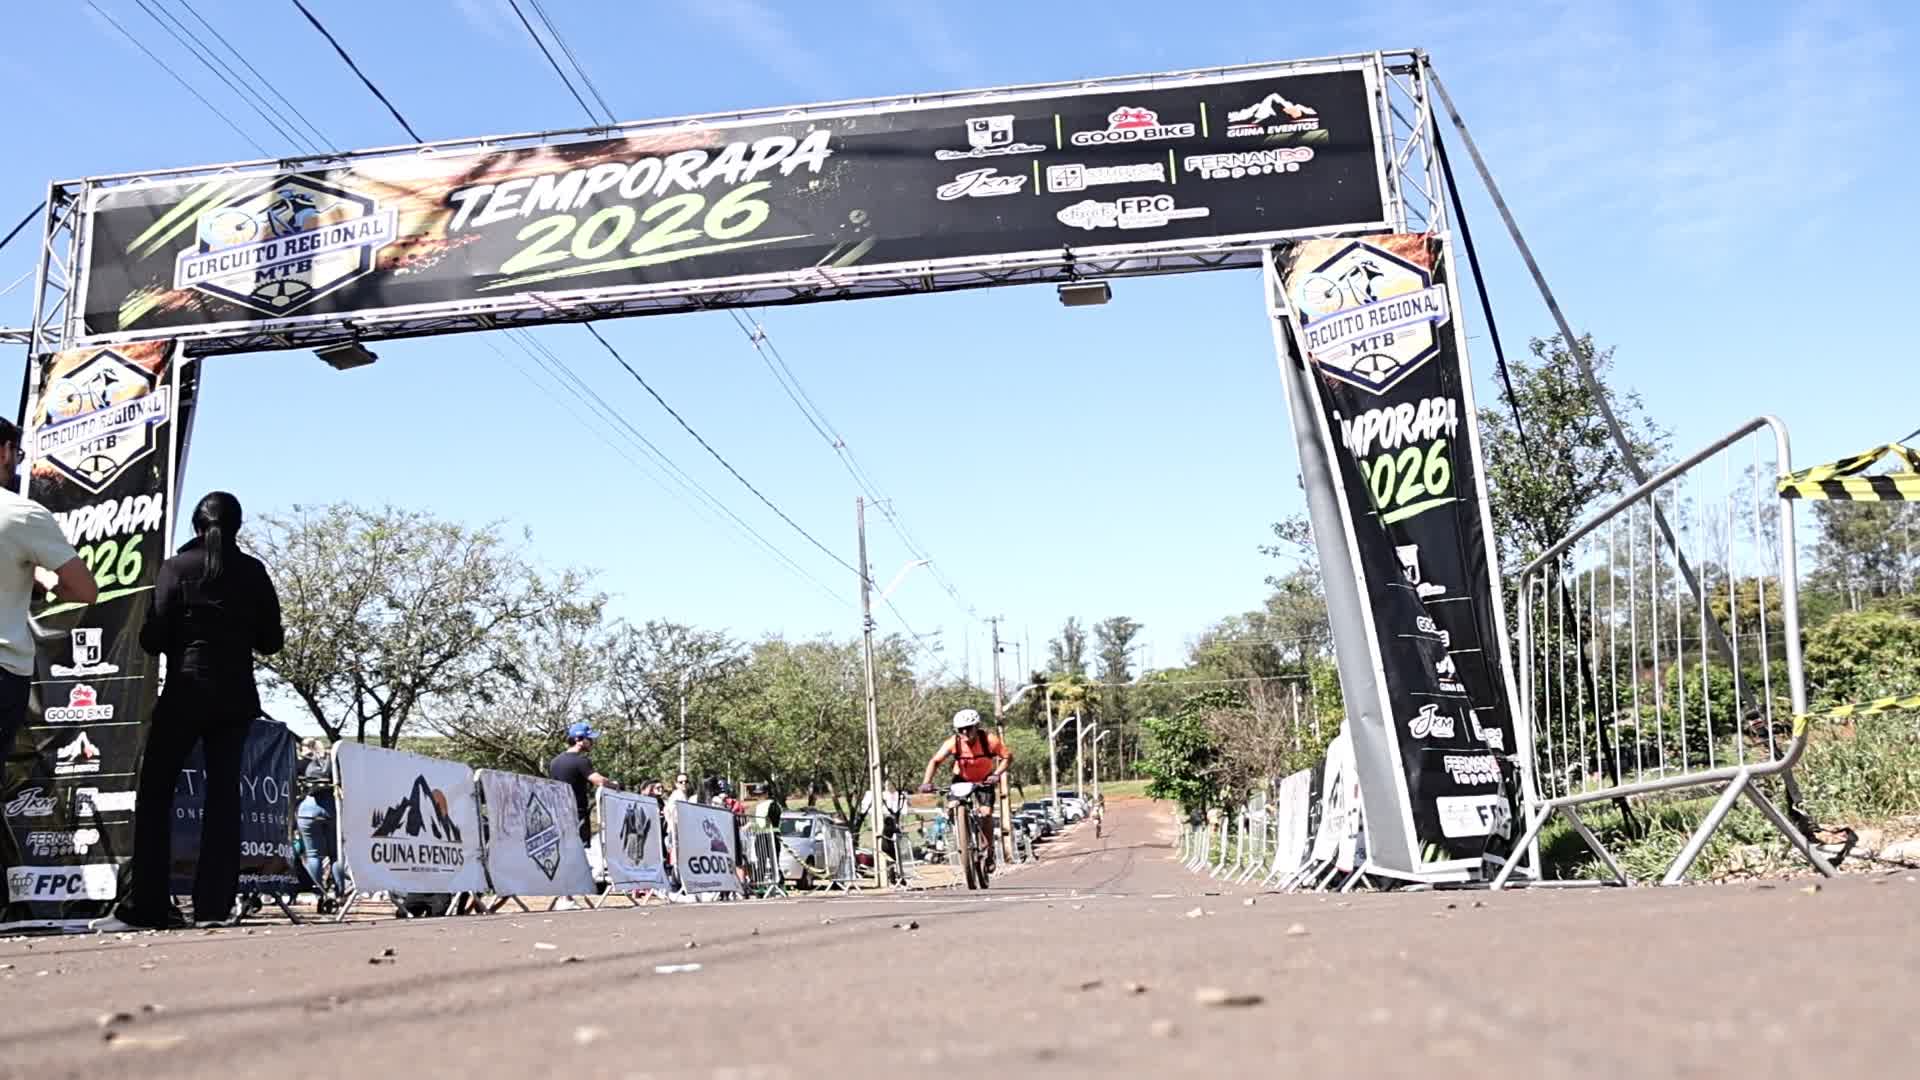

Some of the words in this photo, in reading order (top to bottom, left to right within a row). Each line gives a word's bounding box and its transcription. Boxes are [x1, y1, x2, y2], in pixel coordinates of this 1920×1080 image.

[1073, 129, 1137, 144] GOOD
[1144, 124, 1194, 139] BIKE
[1227, 127, 1264, 137] GUINA
[1267, 122, 1318, 134] EVENTOS
[1185, 147, 1314, 171] FERNANDO
[451, 129, 835, 231] TEMPORADA
[500, 181, 773, 275] 2026
[187, 243, 278, 279] CIRCUITO
[283, 219, 384, 257] REGIONAL
[255, 258, 313, 282] MTB
[1350, 332, 1394, 356] MTB
[40, 419, 96, 451] CIRCUITO
[99, 396, 161, 429] REGIONAL
[80, 435, 117, 457] MTB
[47, 708, 85, 721] GOOD
[371, 843, 416, 864] GUINA
[418, 845, 465, 867] EVENTOS
[688, 855, 727, 875] GOOD
